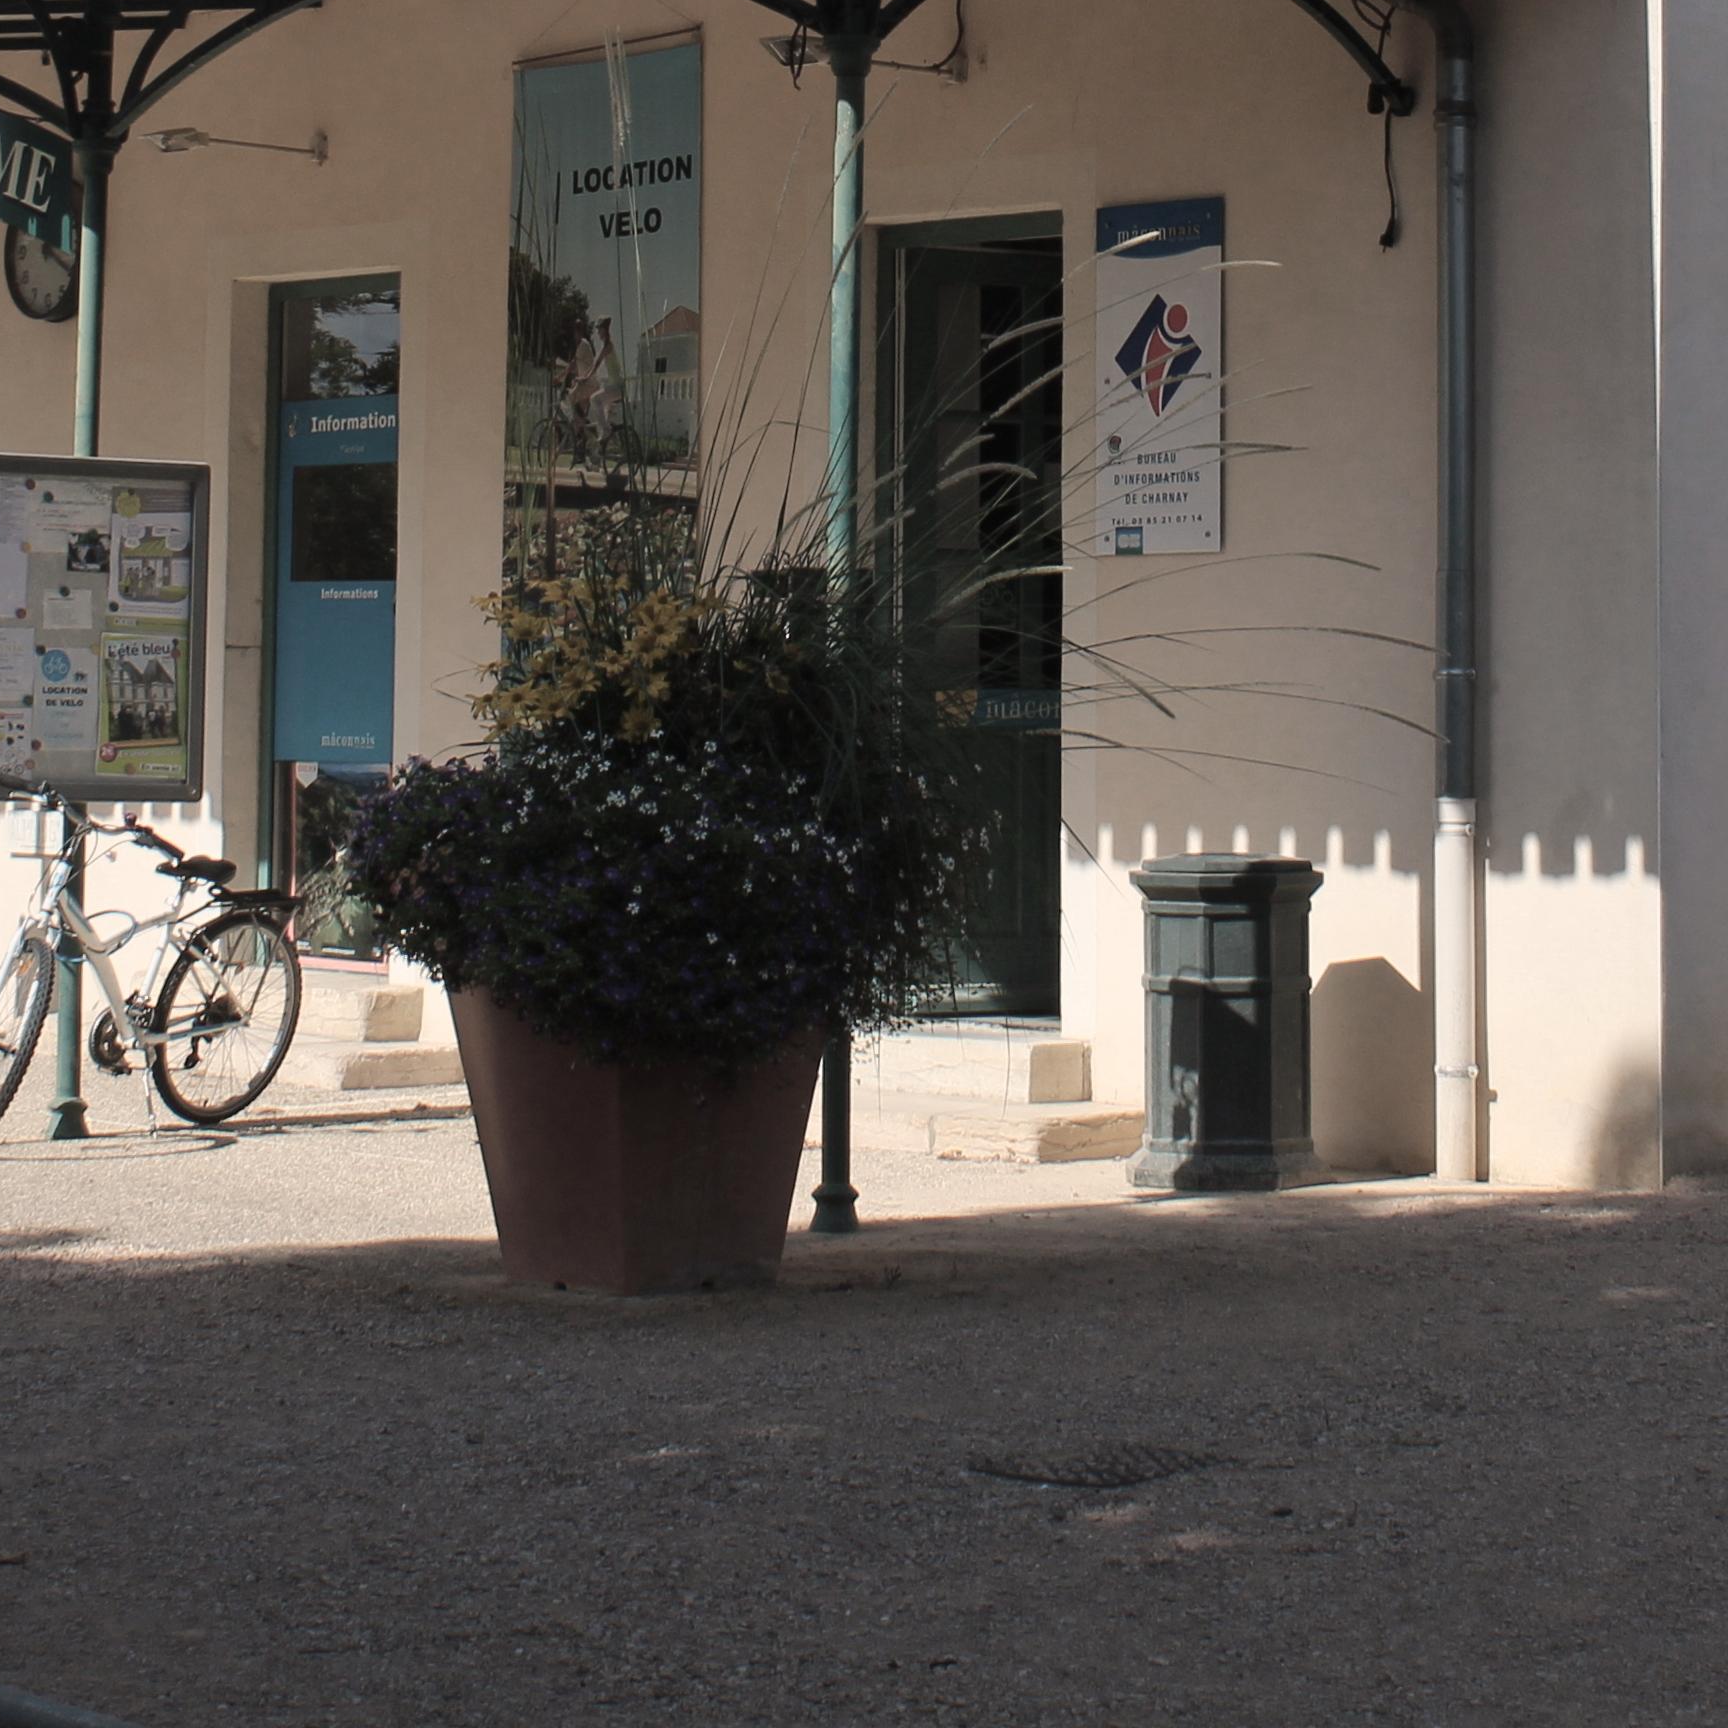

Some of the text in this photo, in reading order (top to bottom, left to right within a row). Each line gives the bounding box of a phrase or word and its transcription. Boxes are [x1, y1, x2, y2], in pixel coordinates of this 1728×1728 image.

[572, 154, 693, 239] LOCATION VELO
[310, 411, 396, 433] Information
[1137, 452, 1177, 465] BUREAU
[1114, 471, 1201, 486] D'INFORMATIONS
[1125, 492, 1189, 505] DE CHARNAY
[320, 587, 379, 600] Informations
[108, 642, 171, 658] L'été bleu
[42, 686, 88, 694] LOCATION
[46, 699, 84, 707] DE VELO
